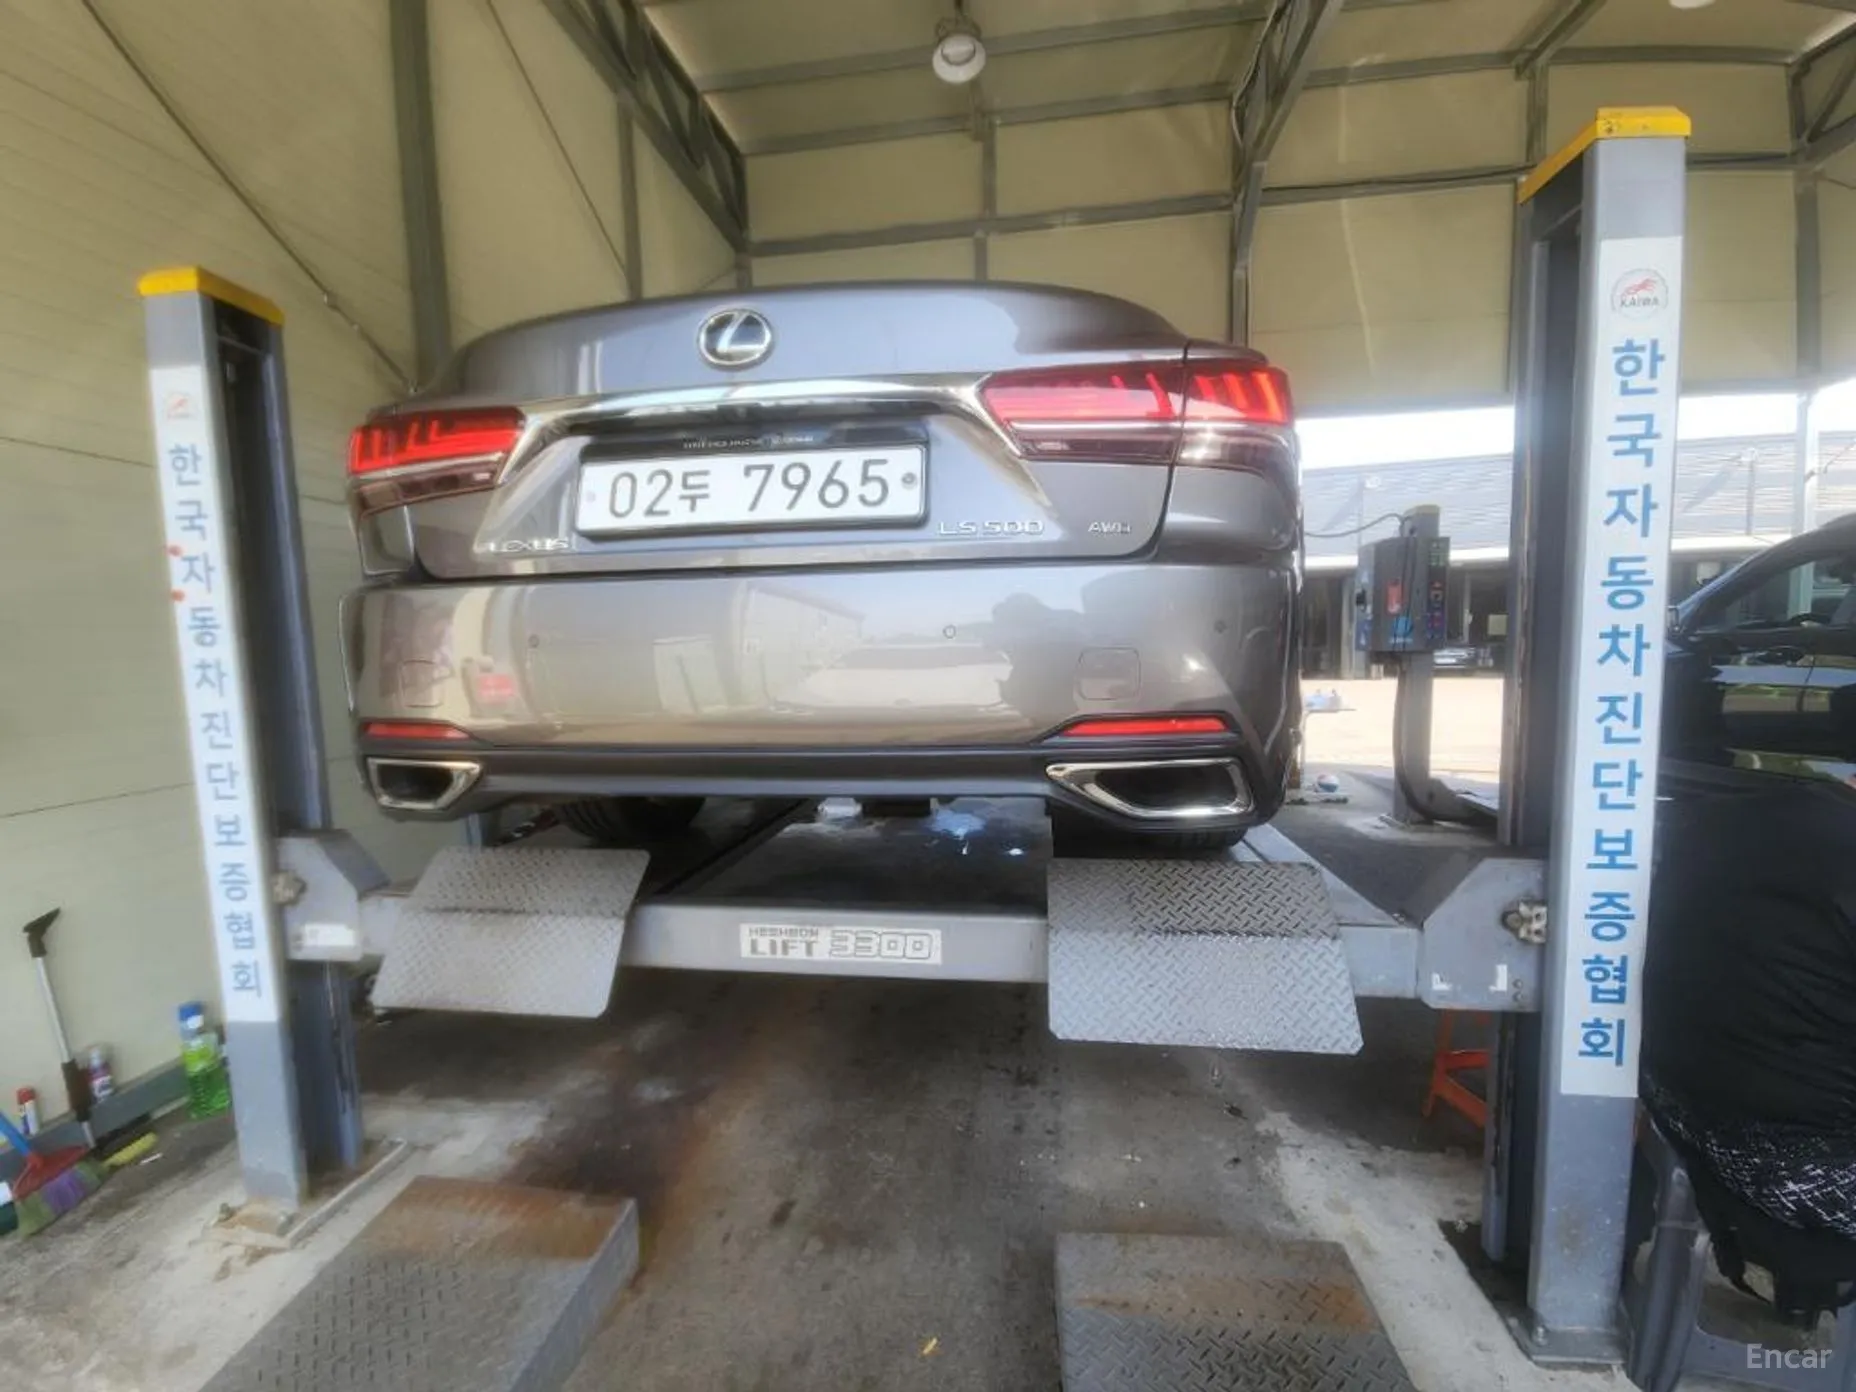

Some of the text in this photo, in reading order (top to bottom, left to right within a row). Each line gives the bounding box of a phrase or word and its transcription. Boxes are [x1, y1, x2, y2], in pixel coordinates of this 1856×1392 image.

[609, 458, 890, 519] 02두 7965
[939, 520, 1044, 536] LS 500
[168, 443, 262, 998] 한국자동차진단보증협회
[1578, 339, 1666, 1067] 한국자동차진단보증협회
[749, 929, 933, 960] LIFT 3300
